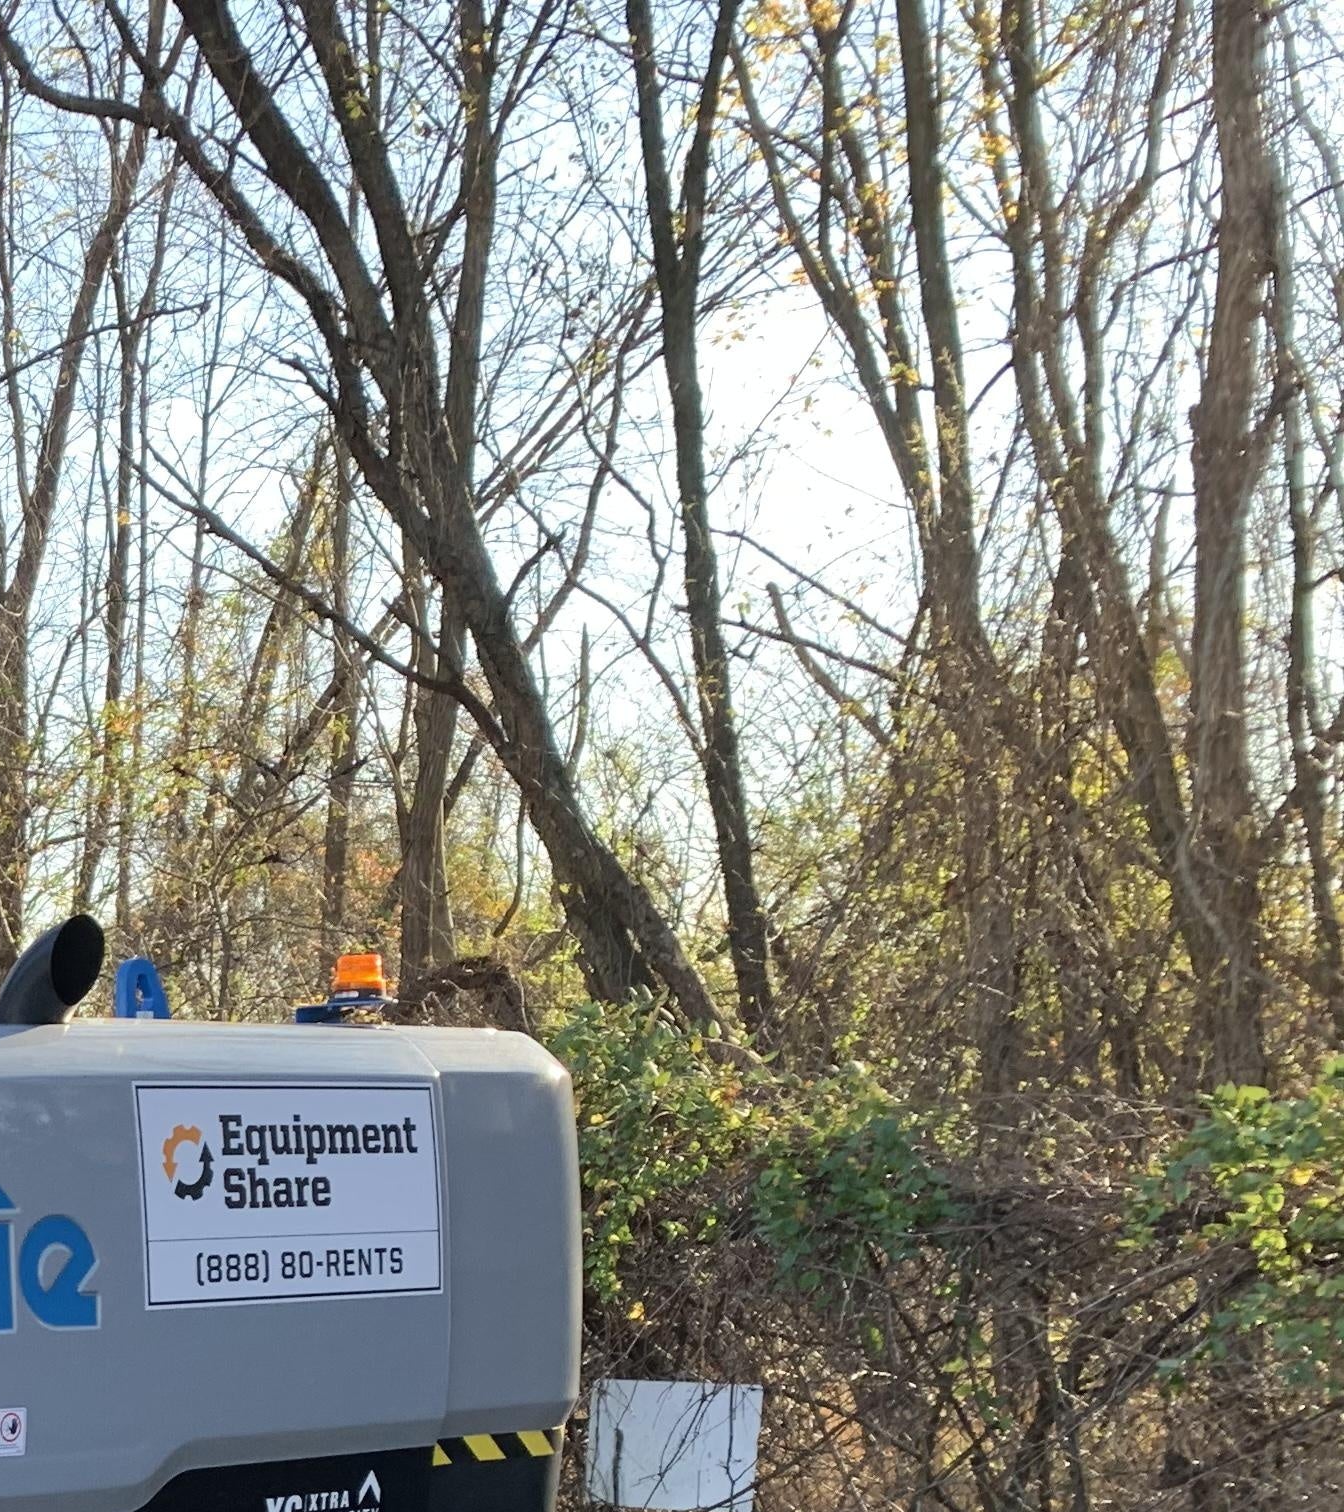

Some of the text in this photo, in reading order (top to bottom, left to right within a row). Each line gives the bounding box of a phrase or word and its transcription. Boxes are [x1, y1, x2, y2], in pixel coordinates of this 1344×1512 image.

[218, 1114, 419, 1166] Equipment
[223, 1167, 333, 1210] Share
[196, 1247, 404, 1287] (888) 80-RENTS
[308, 1490, 350, 1512] XTRA
